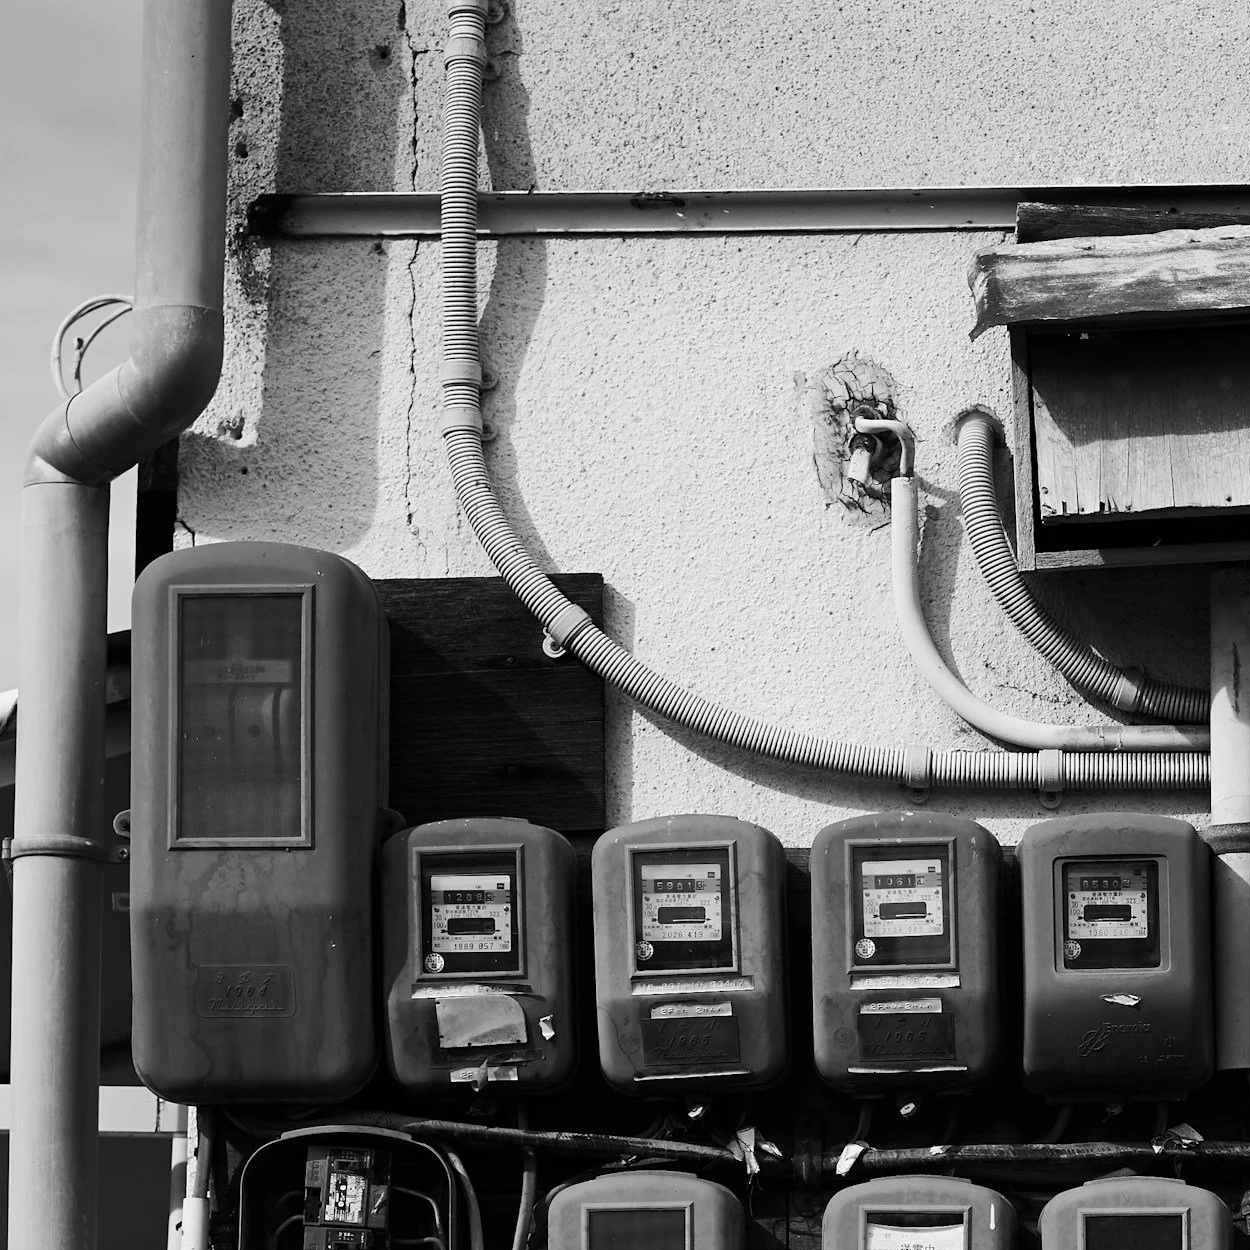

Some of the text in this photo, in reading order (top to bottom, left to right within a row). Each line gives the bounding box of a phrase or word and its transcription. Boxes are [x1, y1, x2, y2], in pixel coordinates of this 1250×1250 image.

[662, 931, 683, 939] 2026
[1089, 929, 1109, 937] 1360
[454, 942, 474, 950] 1989
[208, 997, 286, 1016] Naigai
